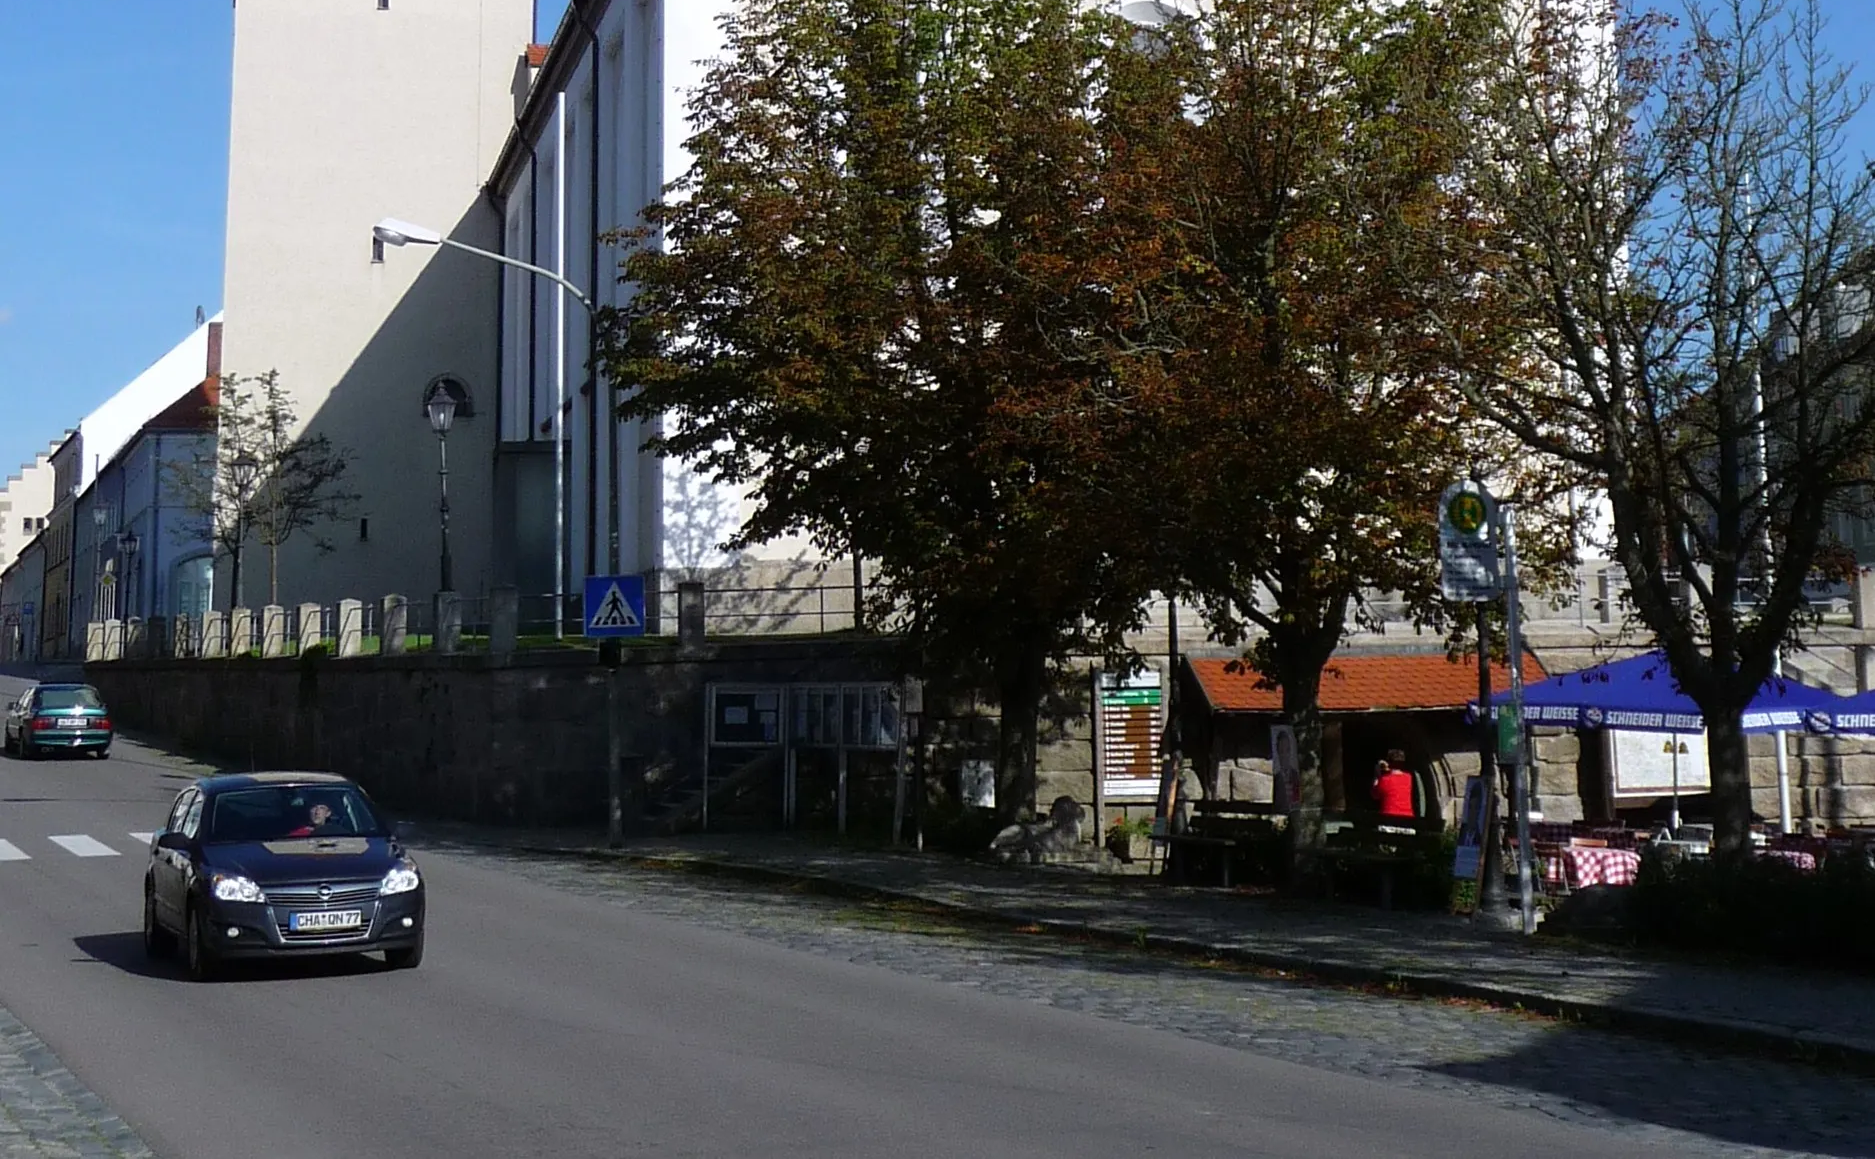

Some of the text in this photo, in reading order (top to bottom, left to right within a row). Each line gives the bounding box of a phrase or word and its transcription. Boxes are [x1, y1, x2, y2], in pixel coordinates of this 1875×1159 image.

[1542, 706, 1580, 720] WEISSE
[1606, 710, 1704, 729] SCHNEIDER WEISSE
[297, 914, 321, 927] CHA
[345, 912, 360, 924] 77
